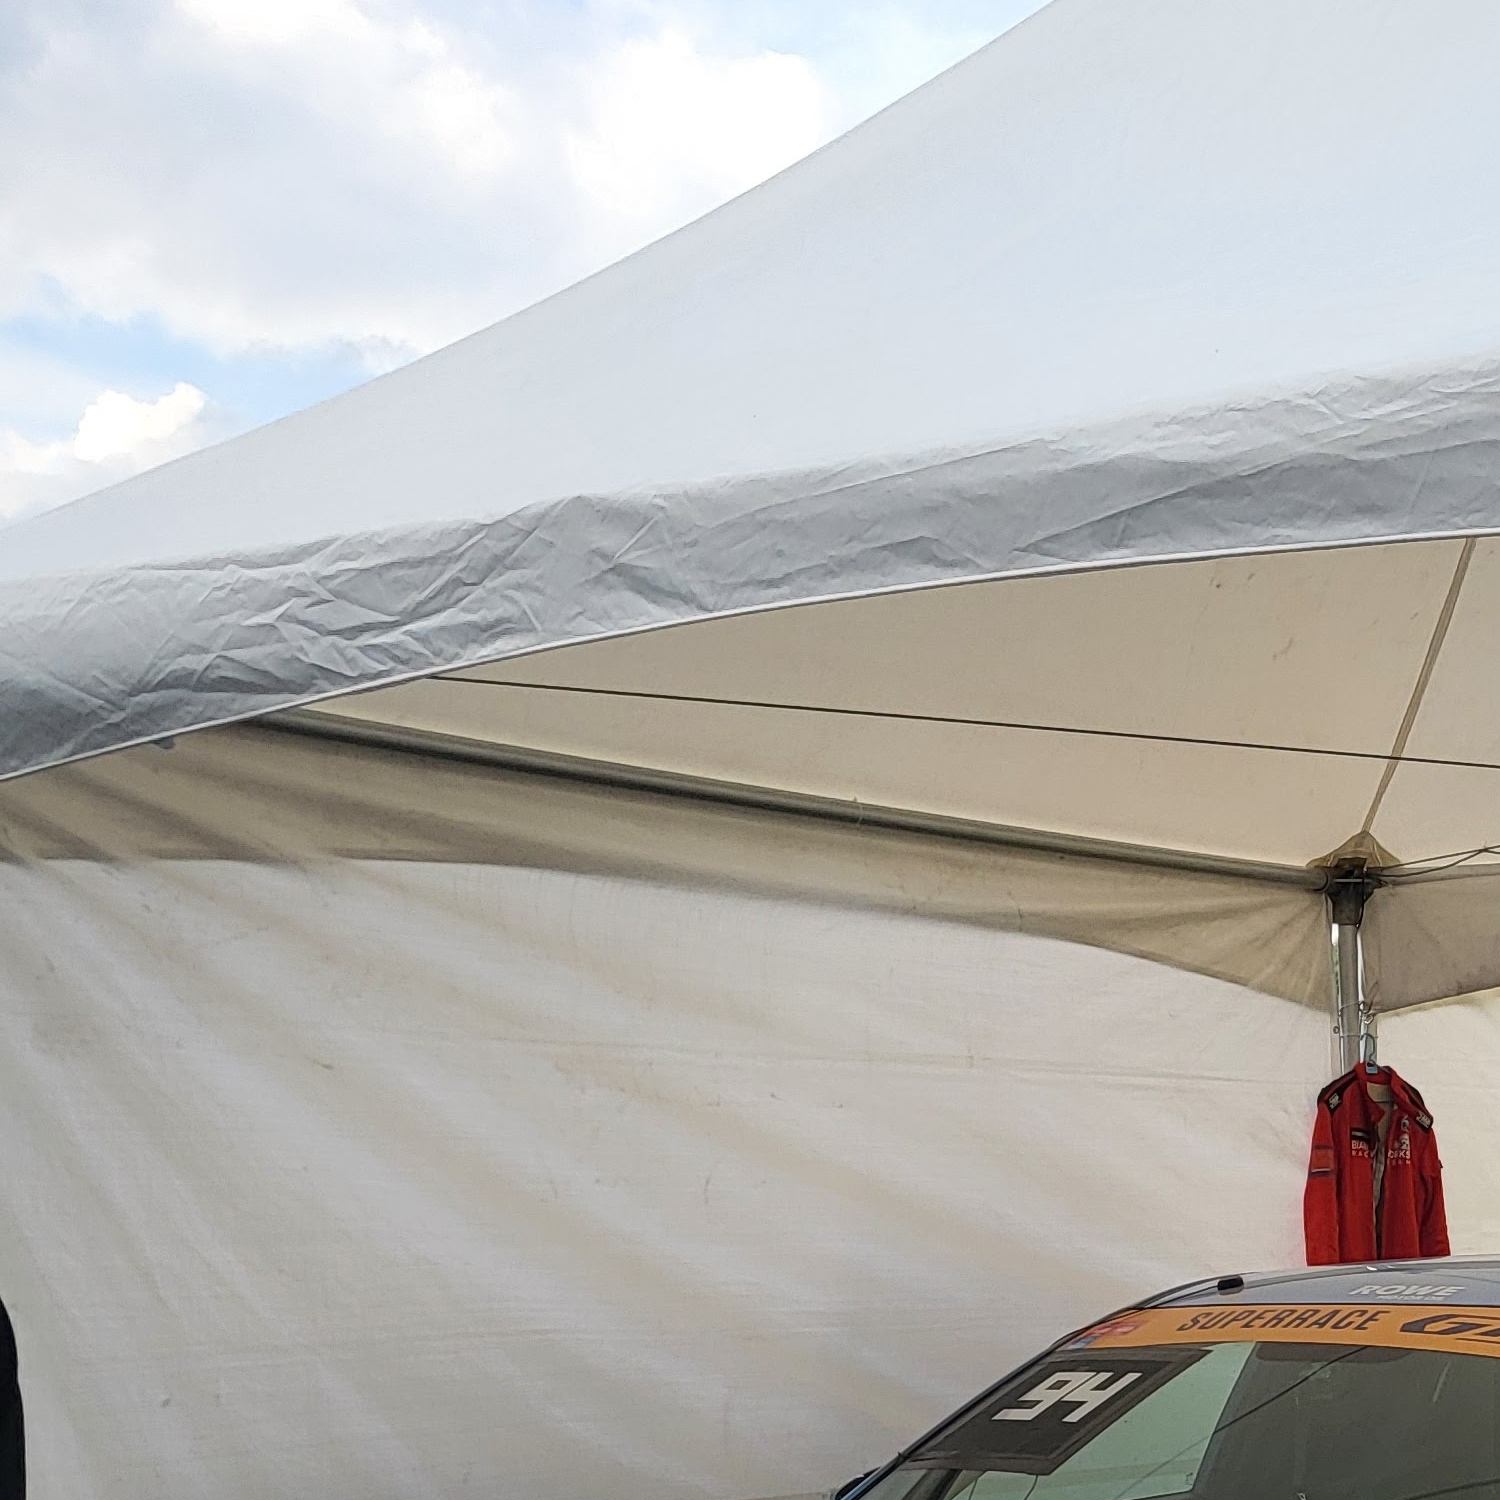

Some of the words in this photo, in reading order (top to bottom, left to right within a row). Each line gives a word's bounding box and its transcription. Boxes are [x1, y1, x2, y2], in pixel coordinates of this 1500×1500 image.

[1349, 1285, 1466, 1296] ROWE
[1176, 1310, 1391, 1332] SUPERRACE
[990, 1370, 1143, 1423] 94
